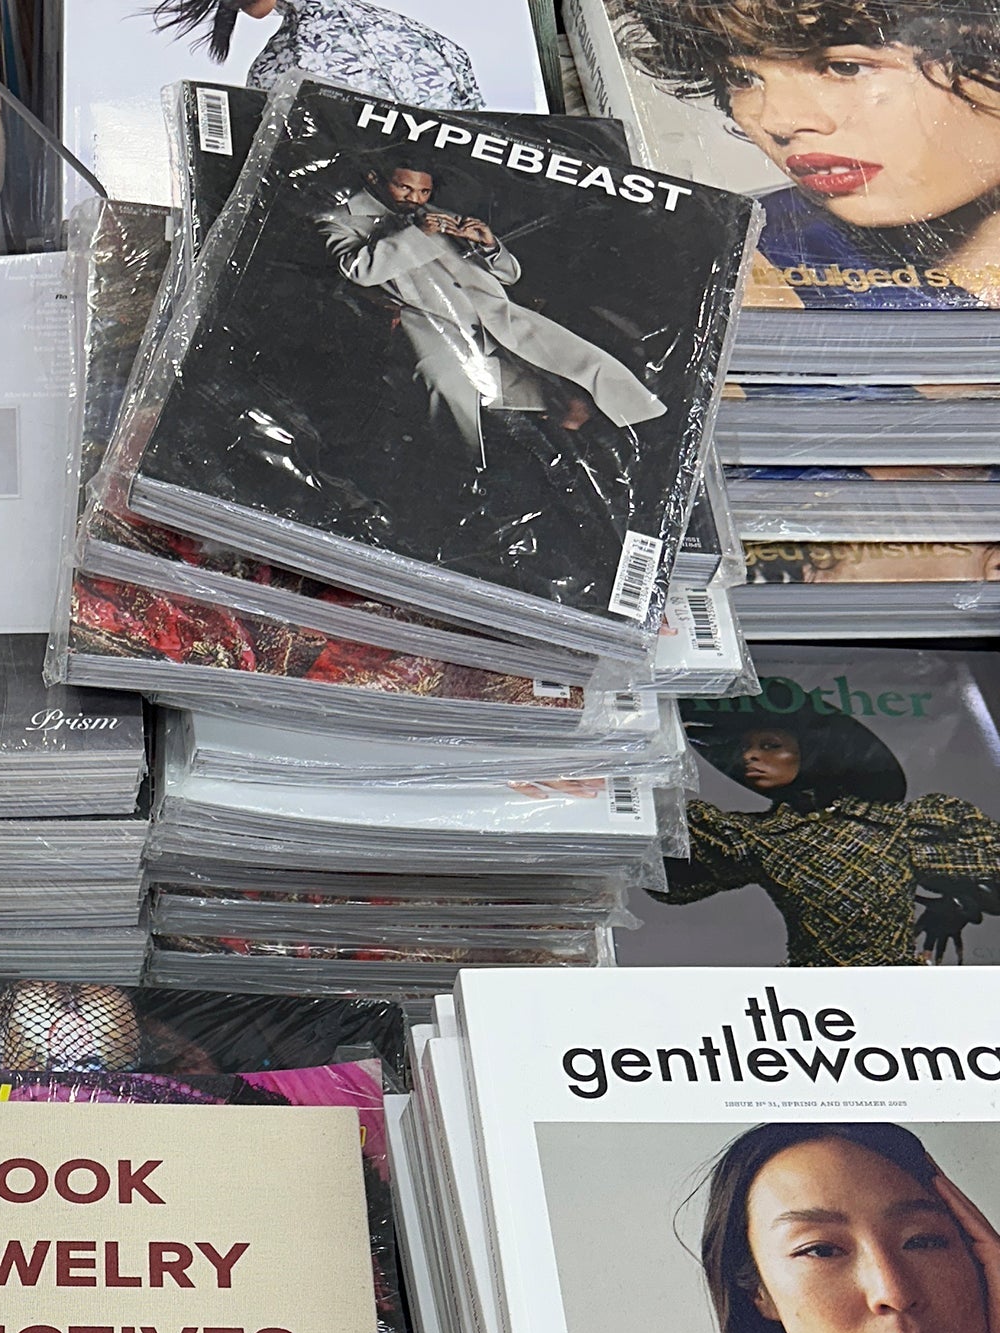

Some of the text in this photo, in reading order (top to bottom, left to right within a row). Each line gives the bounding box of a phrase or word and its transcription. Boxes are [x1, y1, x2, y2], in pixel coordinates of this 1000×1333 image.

[356, 103, 693, 212] HYPEBEAST
[25, 708, 124, 731] Prism
[694, 676, 932, 717] Other
[745, 986, 857, 1042] the
